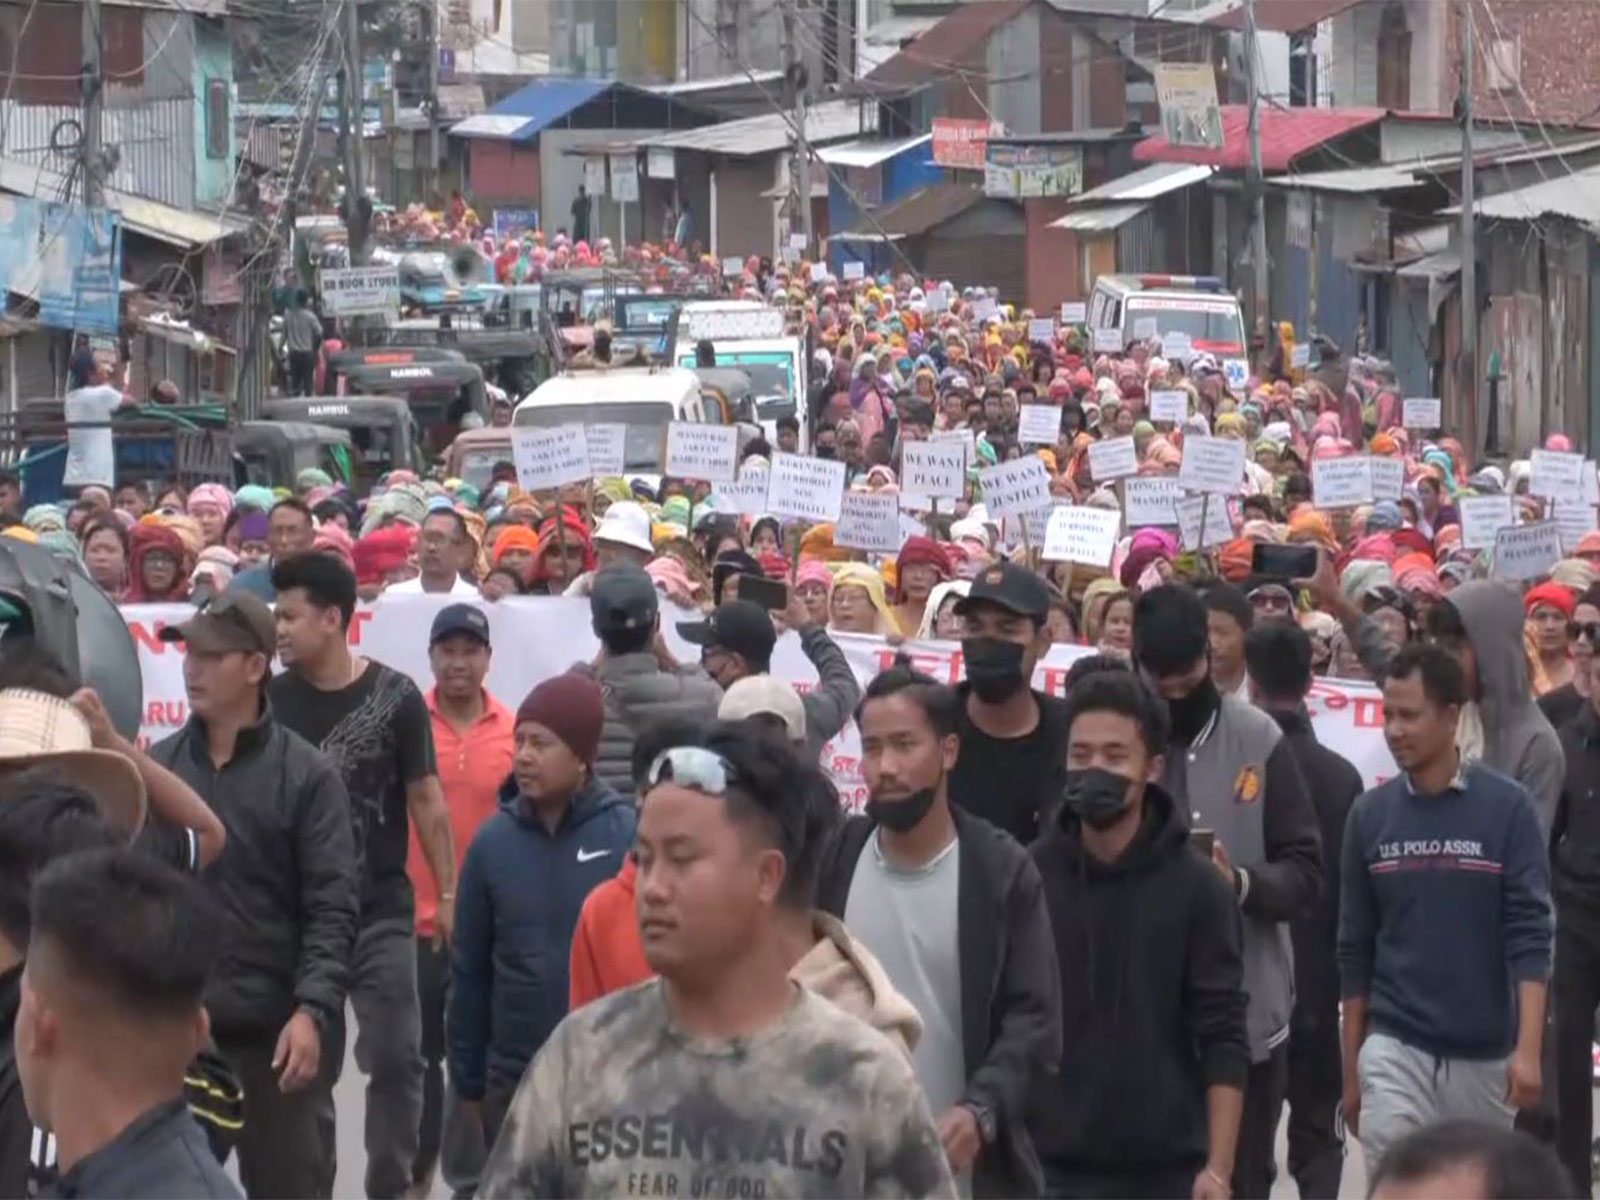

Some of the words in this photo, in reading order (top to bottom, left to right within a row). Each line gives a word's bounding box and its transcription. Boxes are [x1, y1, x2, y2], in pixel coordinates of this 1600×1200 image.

[339, 278, 364, 289] BOOK
[368, 275, 397, 287] STORE
[906, 452, 925, 464] WE
[927, 456, 961, 469] WANT
[914, 473, 950, 487] PEACE
[981, 478, 1003, 490] WE
[1006, 464, 1044, 485] WANT
[993, 485, 1040, 508] JUSTICE
[1403, 840, 1440, 856] POLO
[628, 1173, 678, 1196] FEAR
[690, 1175, 716, 1198] OF
